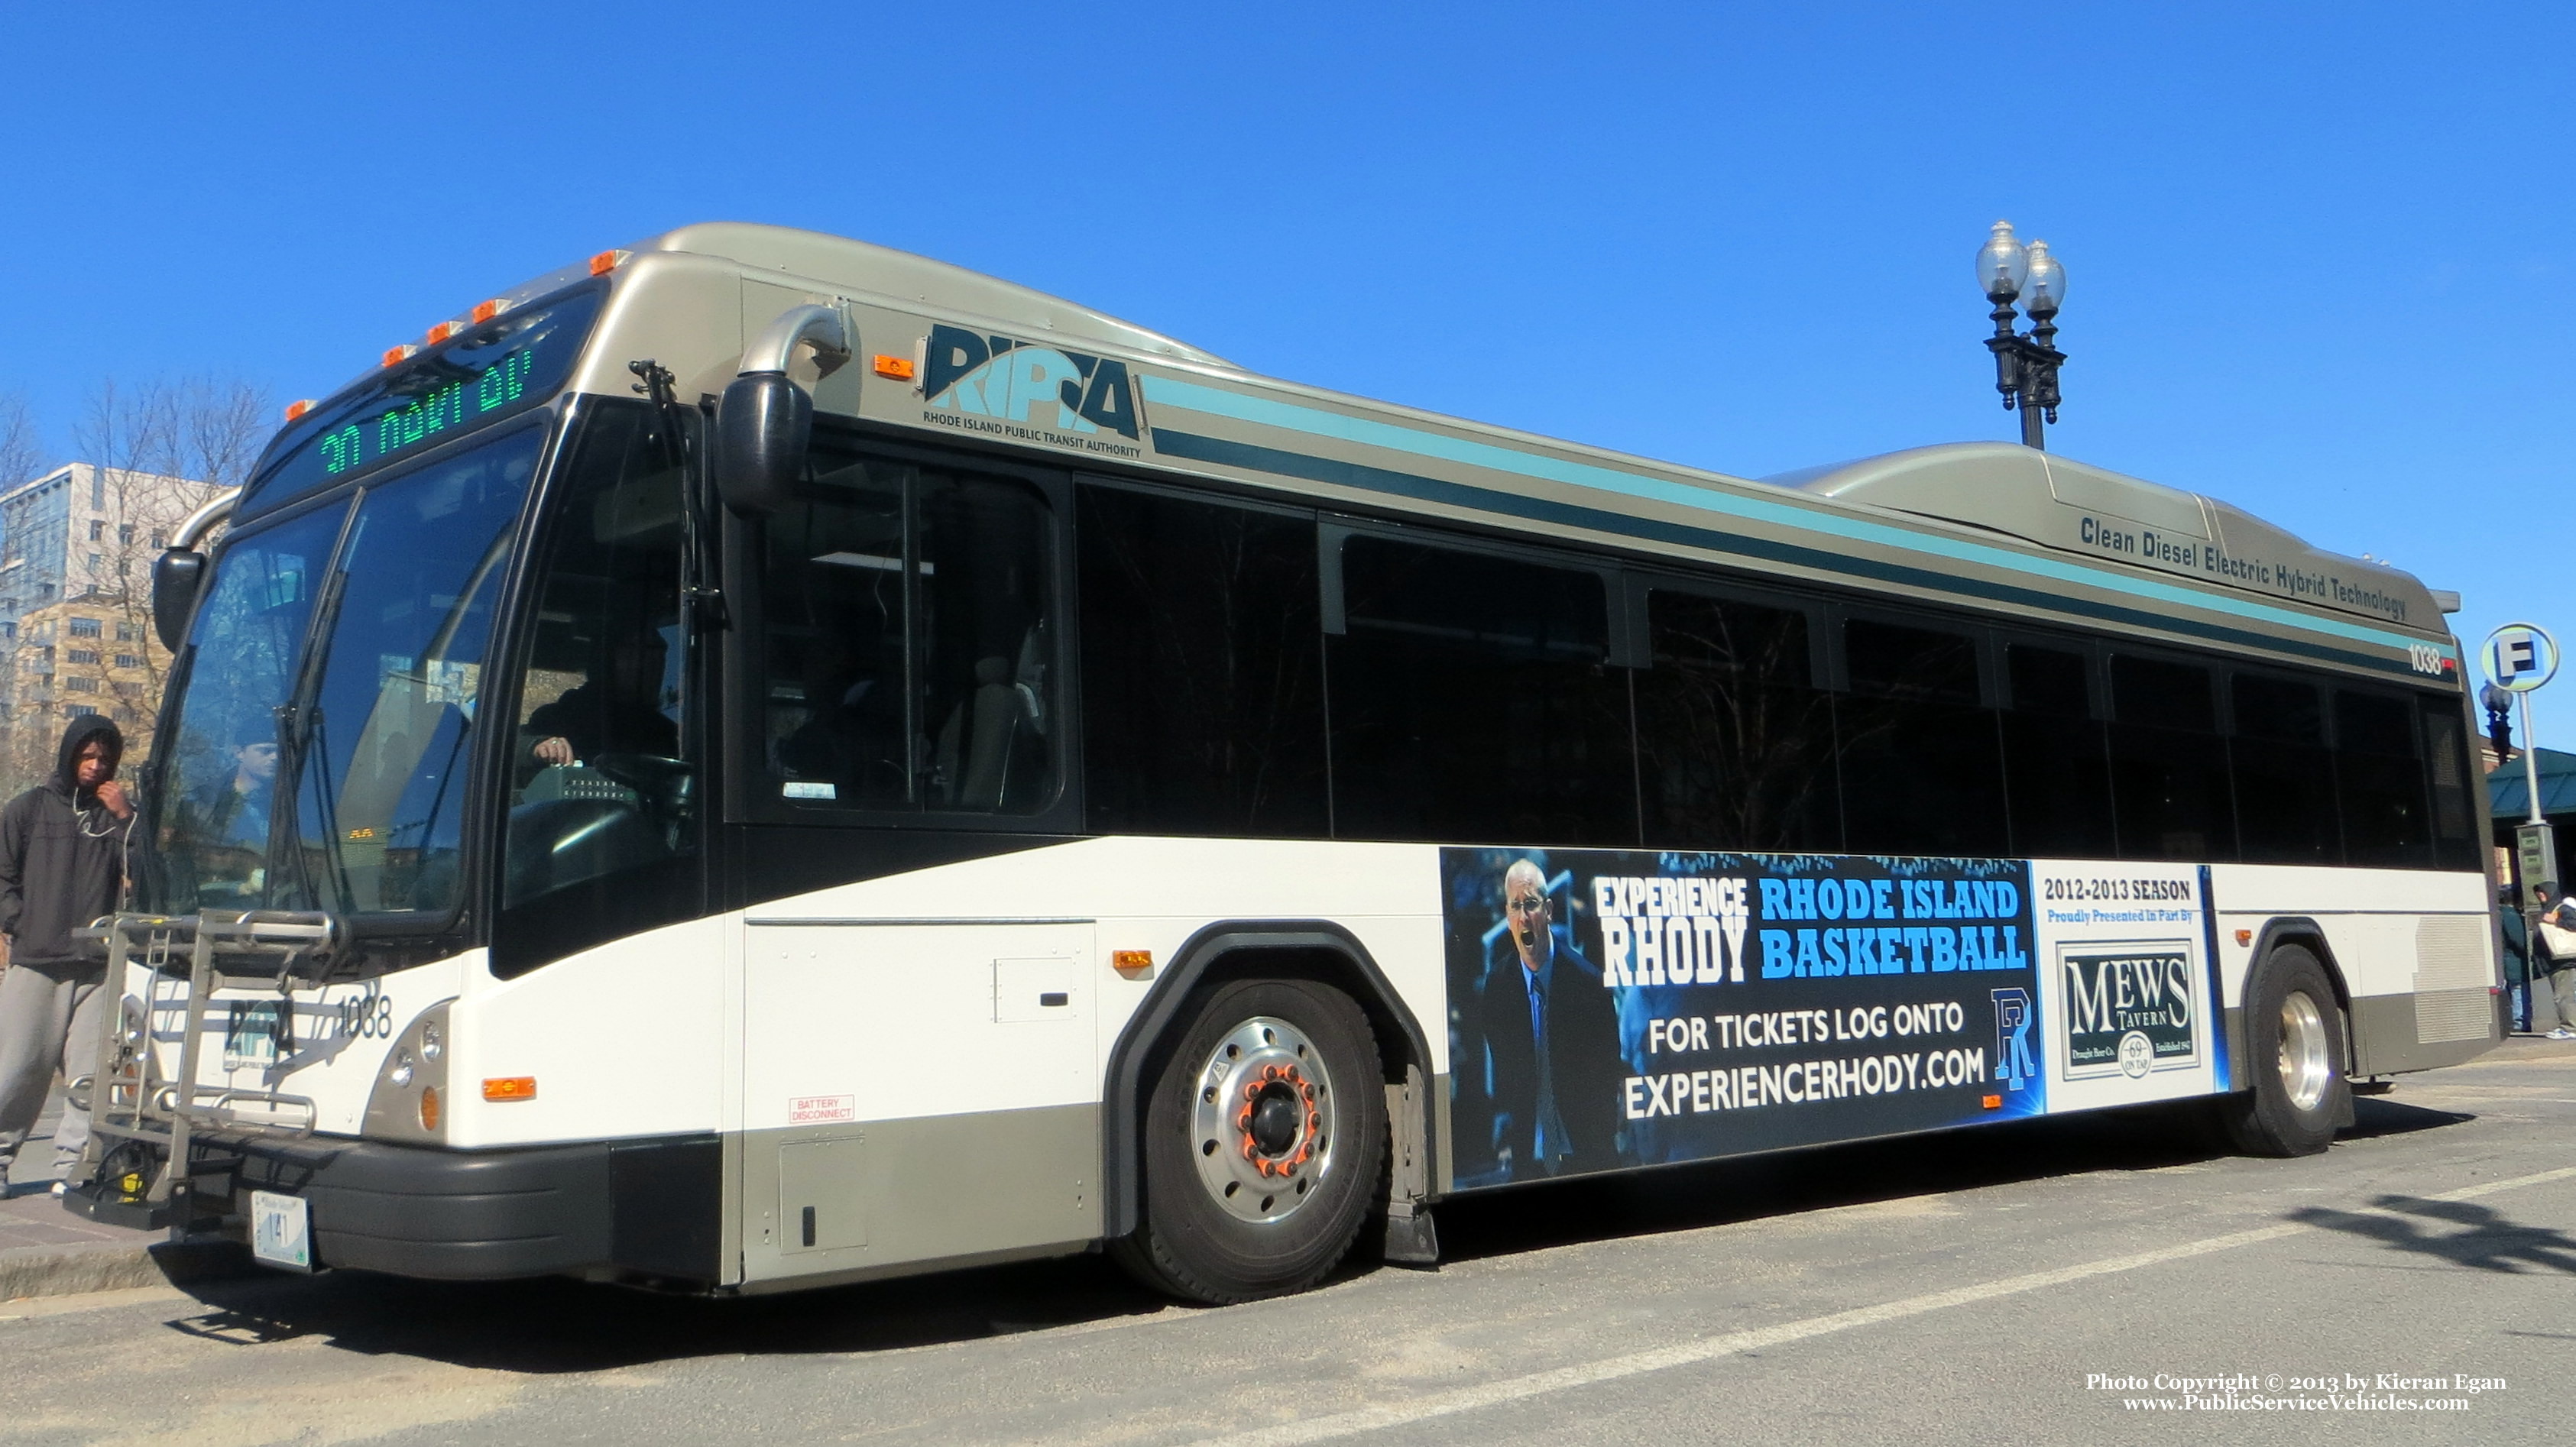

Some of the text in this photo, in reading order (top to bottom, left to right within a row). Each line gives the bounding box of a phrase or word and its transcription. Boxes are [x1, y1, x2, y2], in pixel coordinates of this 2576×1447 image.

[924, 324, 1140, 442] RIPTA
[923, 411, 1142, 458] RHODE ISLAND PUBLIC TRANSIT AUTHORITY
[2080, 517, 2406, 621] Clean Diesel Electric Hybrid Technology
[2409, 643, 2442, 675] 1038
[2494, 632, 2535, 681] F
[1594, 876, 1749, 917] EXPERIENCE
[1759, 878, 2019, 920] RHODE ISLAND
[2044, 878, 2191, 900] 2012-2013 SEASON
[2047, 908, 2192, 926] Proudly Presented In Part By
[1601, 917, 1748, 987] RHODY
[1759, 925, 2027, 979] BASKETBALL
[339, 995, 393, 1039] 1038
[2066, 958, 2189, 1034] MEWS
[1649, 1002, 1964, 1054] FOR TICKETS LOG ONTO
[2116, 1010, 2167, 1031] TAVERN
[797, 1099, 839, 1110] BATTERY
[1625, 1047, 1985, 1120] EXPERIENCERHODY.COM
[792, 1108, 852, 1121] DISCONNECT
